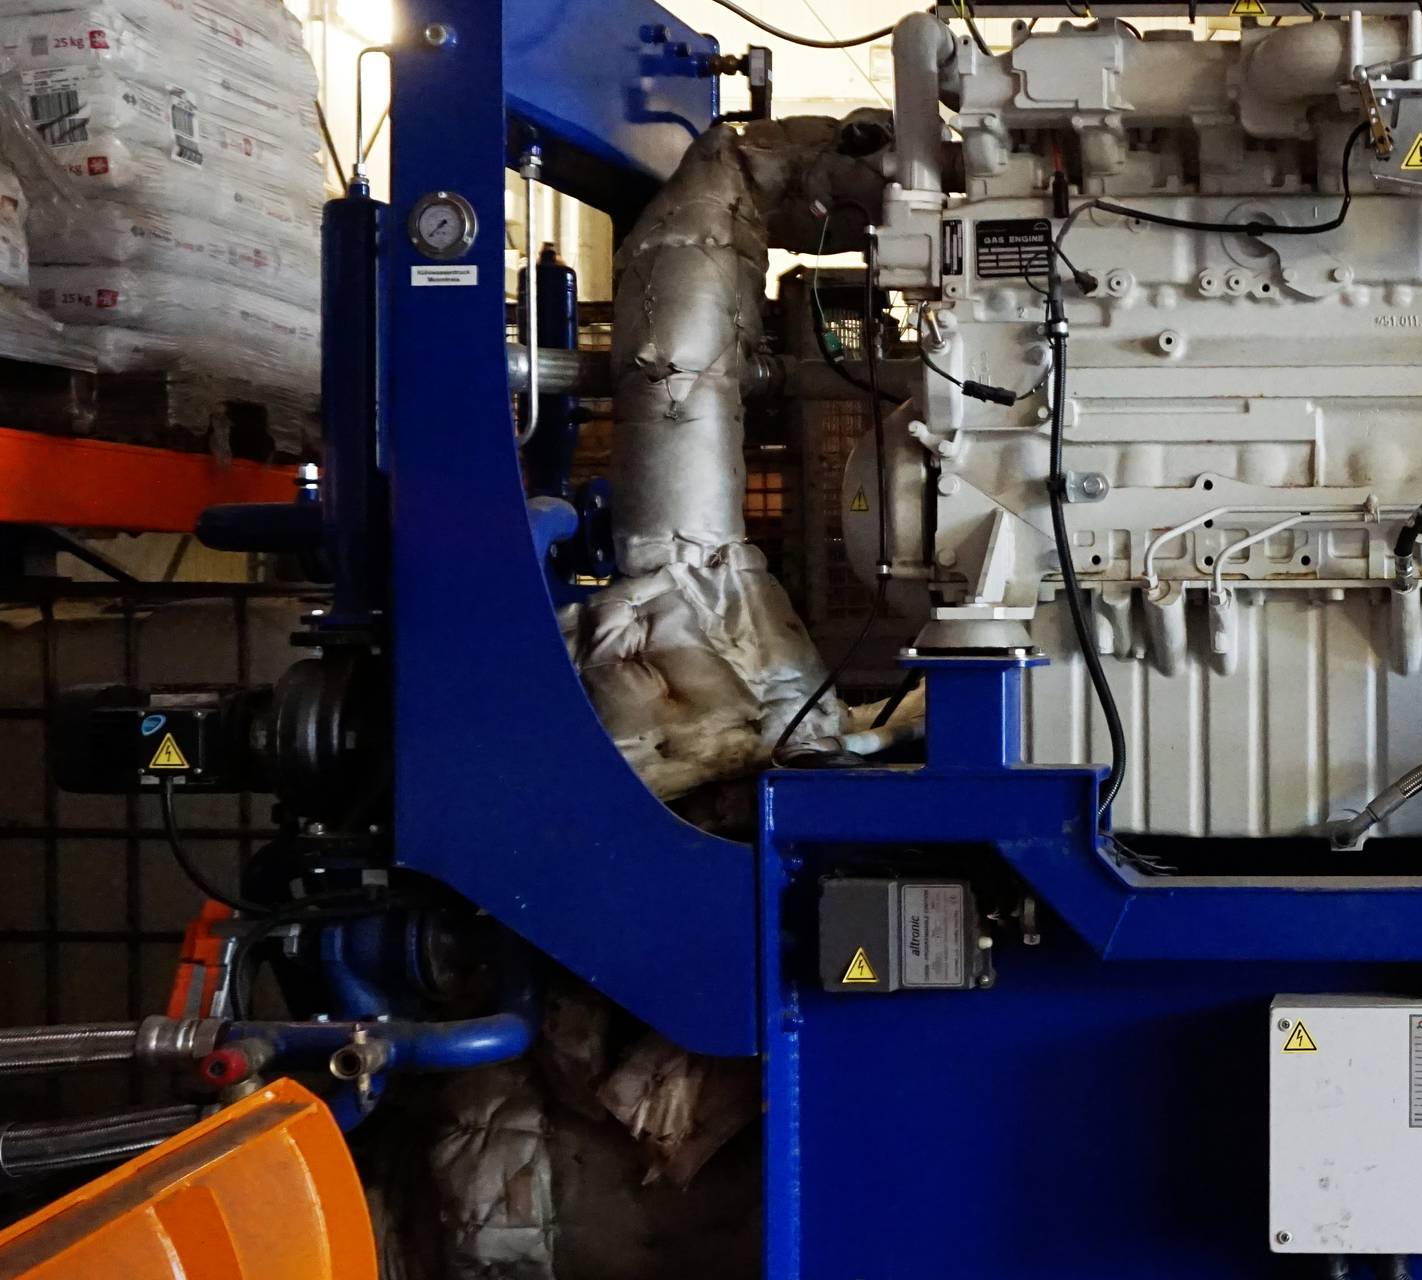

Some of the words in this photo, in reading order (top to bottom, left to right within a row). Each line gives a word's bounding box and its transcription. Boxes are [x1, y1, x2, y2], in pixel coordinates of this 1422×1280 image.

[54, 38, 68, 48] 25
[70, 36, 85, 49] kg
[984, 236, 1005, 244] GAS
[1009, 235, 1044, 243] ENGINE
[910, 915, 920, 957] altronic
